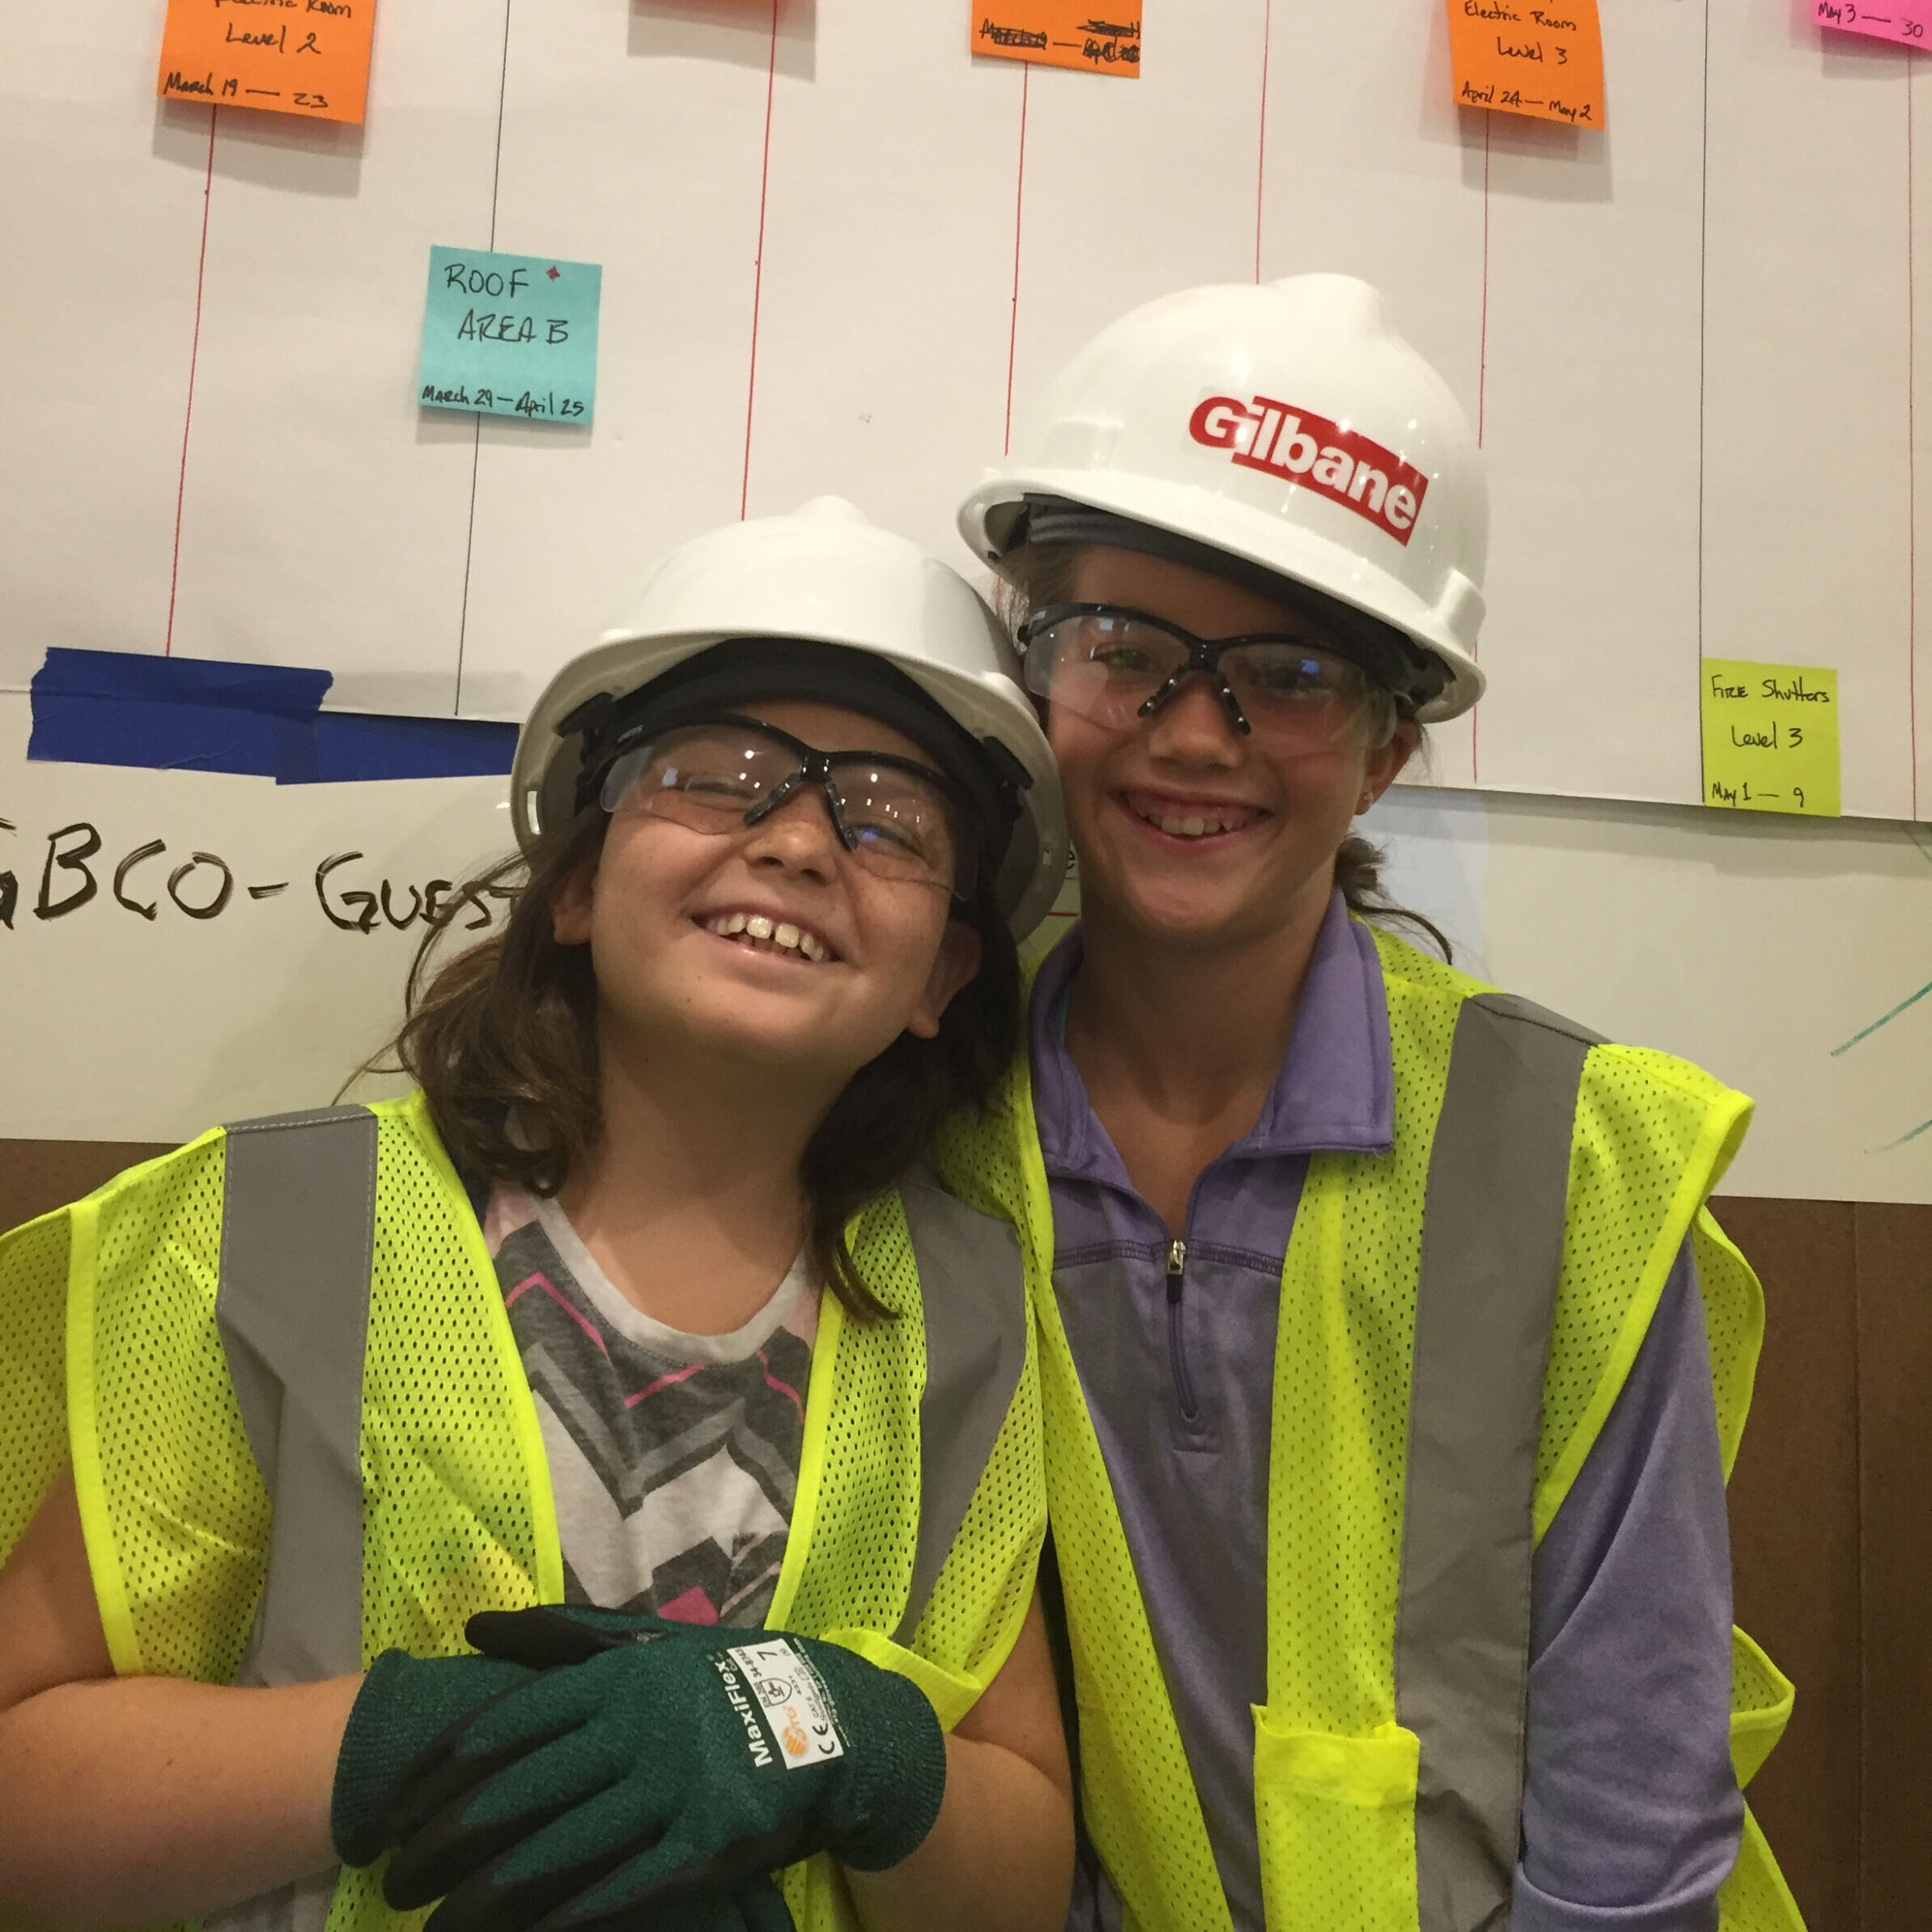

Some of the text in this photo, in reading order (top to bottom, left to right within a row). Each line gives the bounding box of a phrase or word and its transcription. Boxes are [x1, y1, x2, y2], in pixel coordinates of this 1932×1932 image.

[1464, 0, 1577, 31] Electric Room
[1845, 4, 1856, 23] 3
[1902, 18, 1924, 38] 30
[226, 23, 321, 54] Level 2
[1497, 36, 1568, 64] Level 3
[222, 79, 237, 96] 19
[293, 93, 329, 108] 23
[1462, 81, 1494, 103] April
[1549, 100, 1577, 122] May
[1579, 104, 1593, 121] 2
[444, 263, 529, 298] ROOF
[458, 308, 568, 345] AREA B
[474, 389, 493, 408] 29
[515, 391, 554, 418] April
[560, 399, 584, 417] 25
[1189, 397, 1417, 529] Gilbane
[1731, 721, 1803, 749] Level 3
[1743, 782, 1752, 800] 1
[1793, 787, 1804, 808] 9
[757, 1651, 778, 1661] 7
[715, 1660, 773, 1767] MaxiFlex
